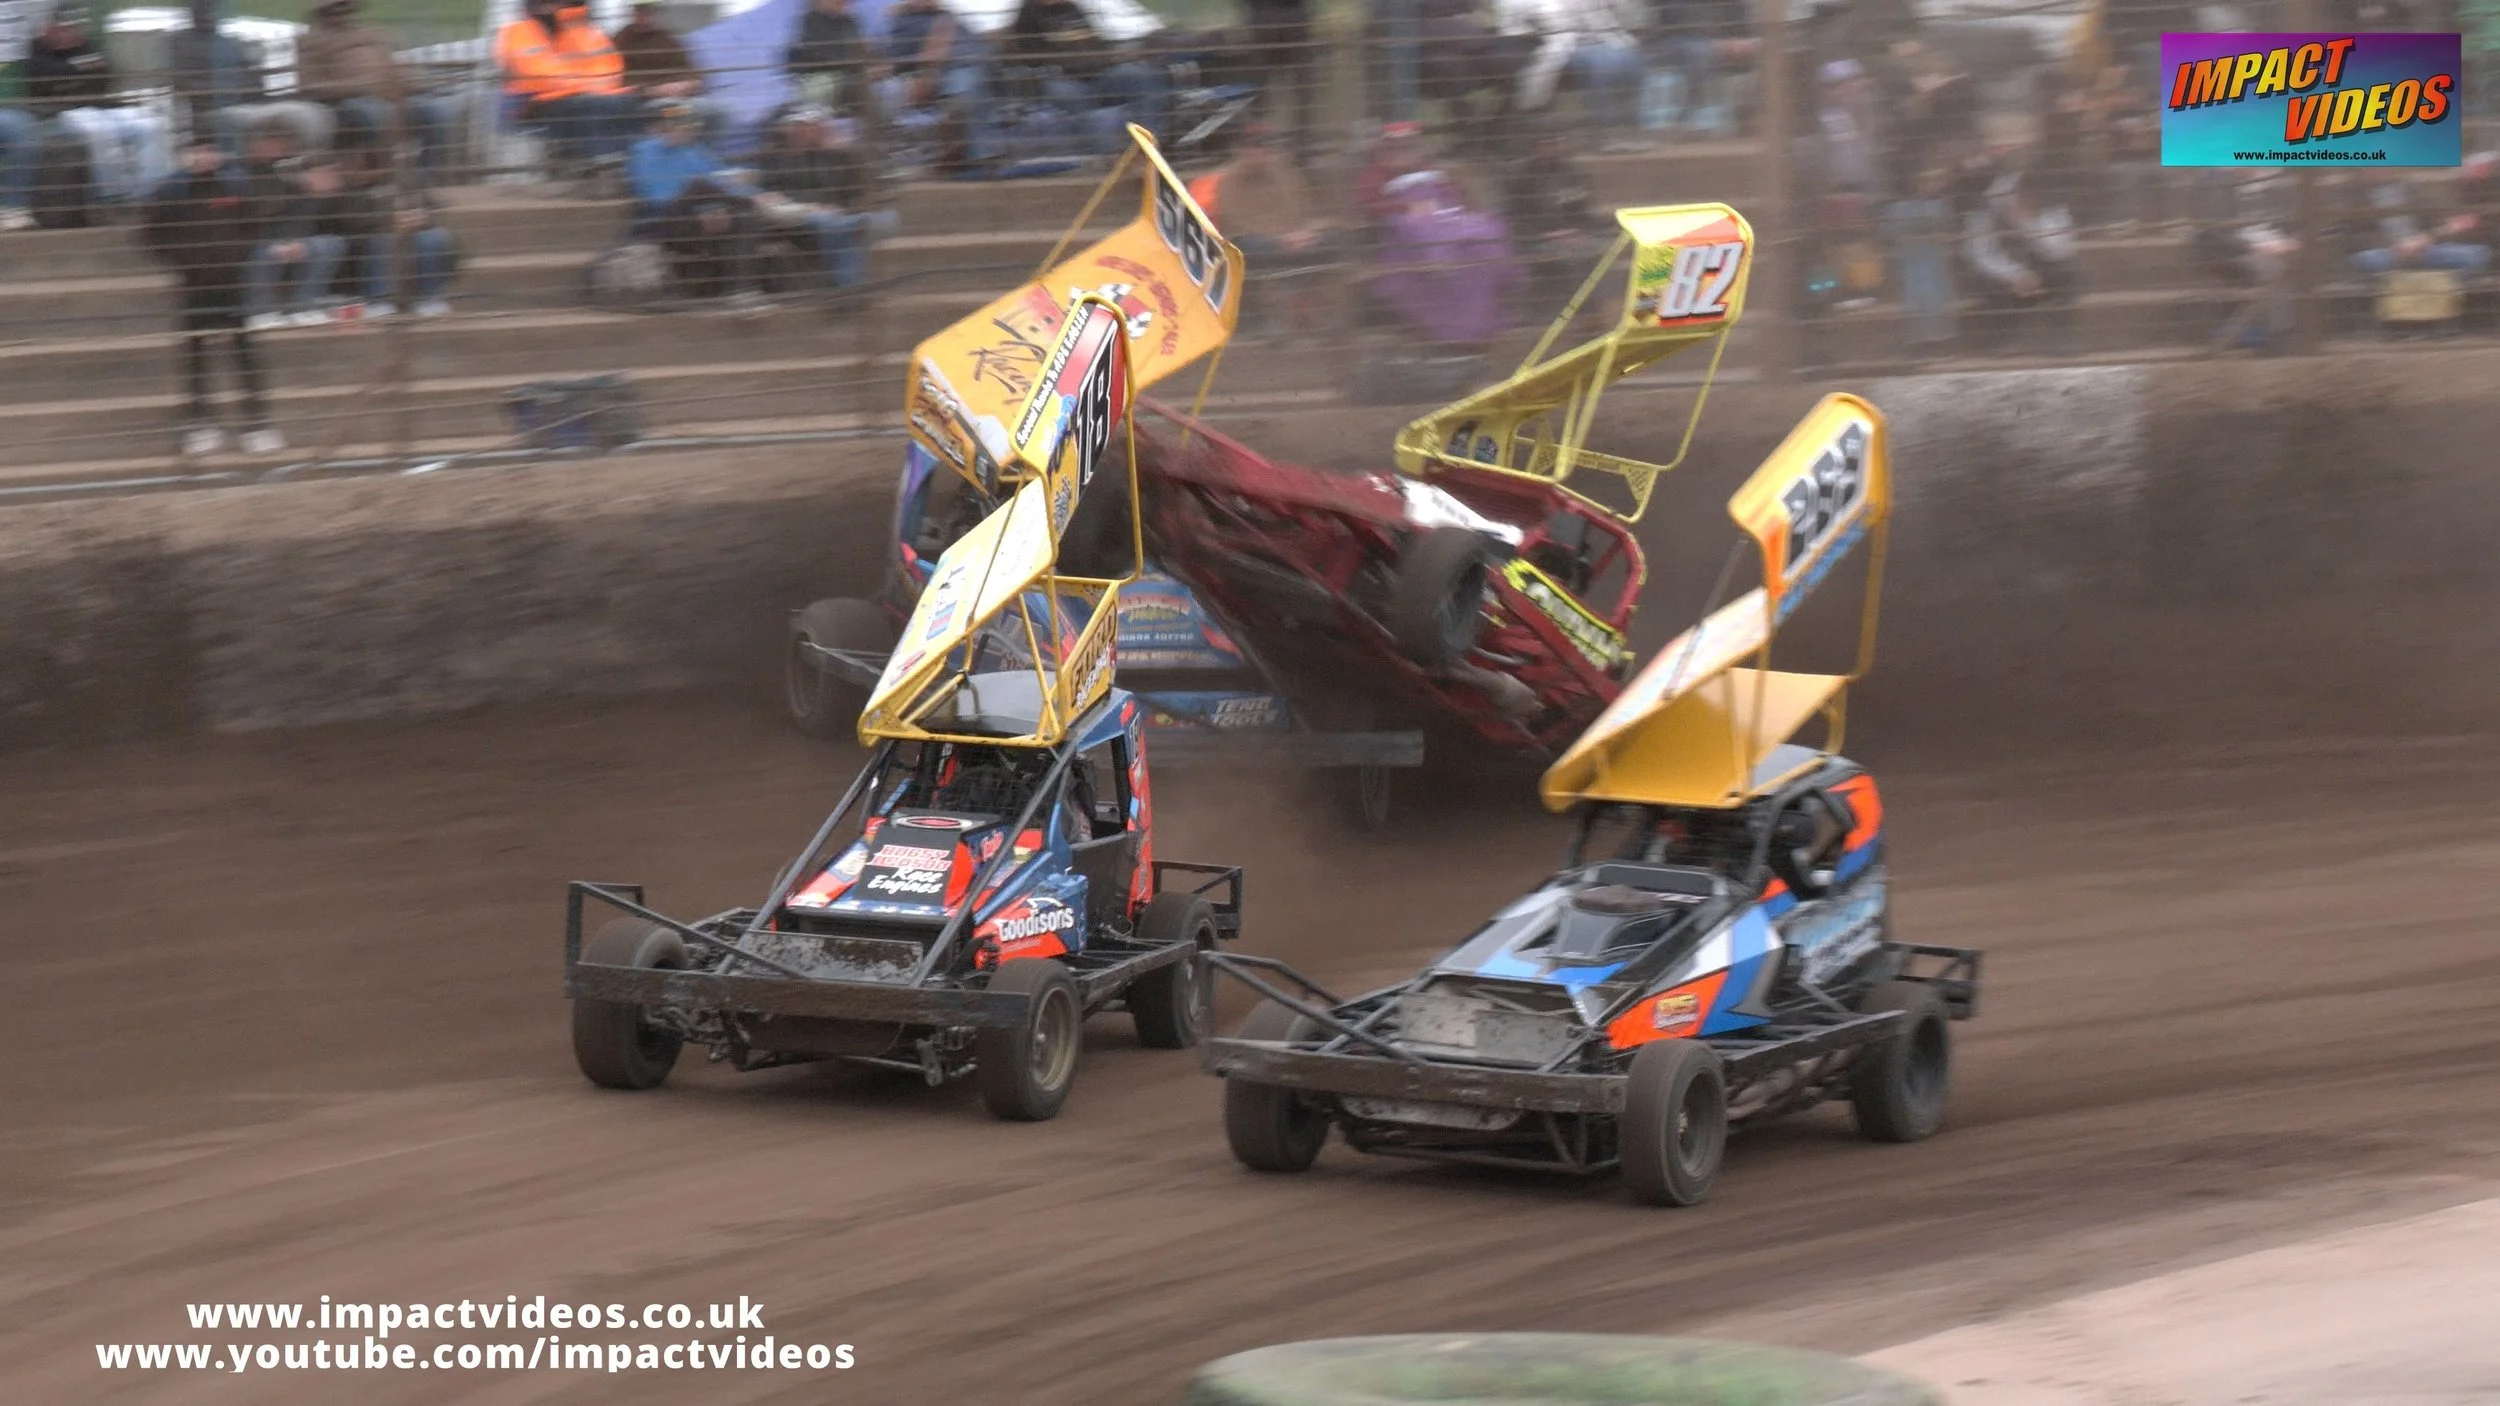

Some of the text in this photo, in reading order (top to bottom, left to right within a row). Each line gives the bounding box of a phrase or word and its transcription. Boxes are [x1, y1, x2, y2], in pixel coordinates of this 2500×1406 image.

[1658, 241, 1745, 322] 82
[1076, 320, 1118, 488] 18
[867, 874, 943, 895] Engines
[891, 867, 943, 882] Race
